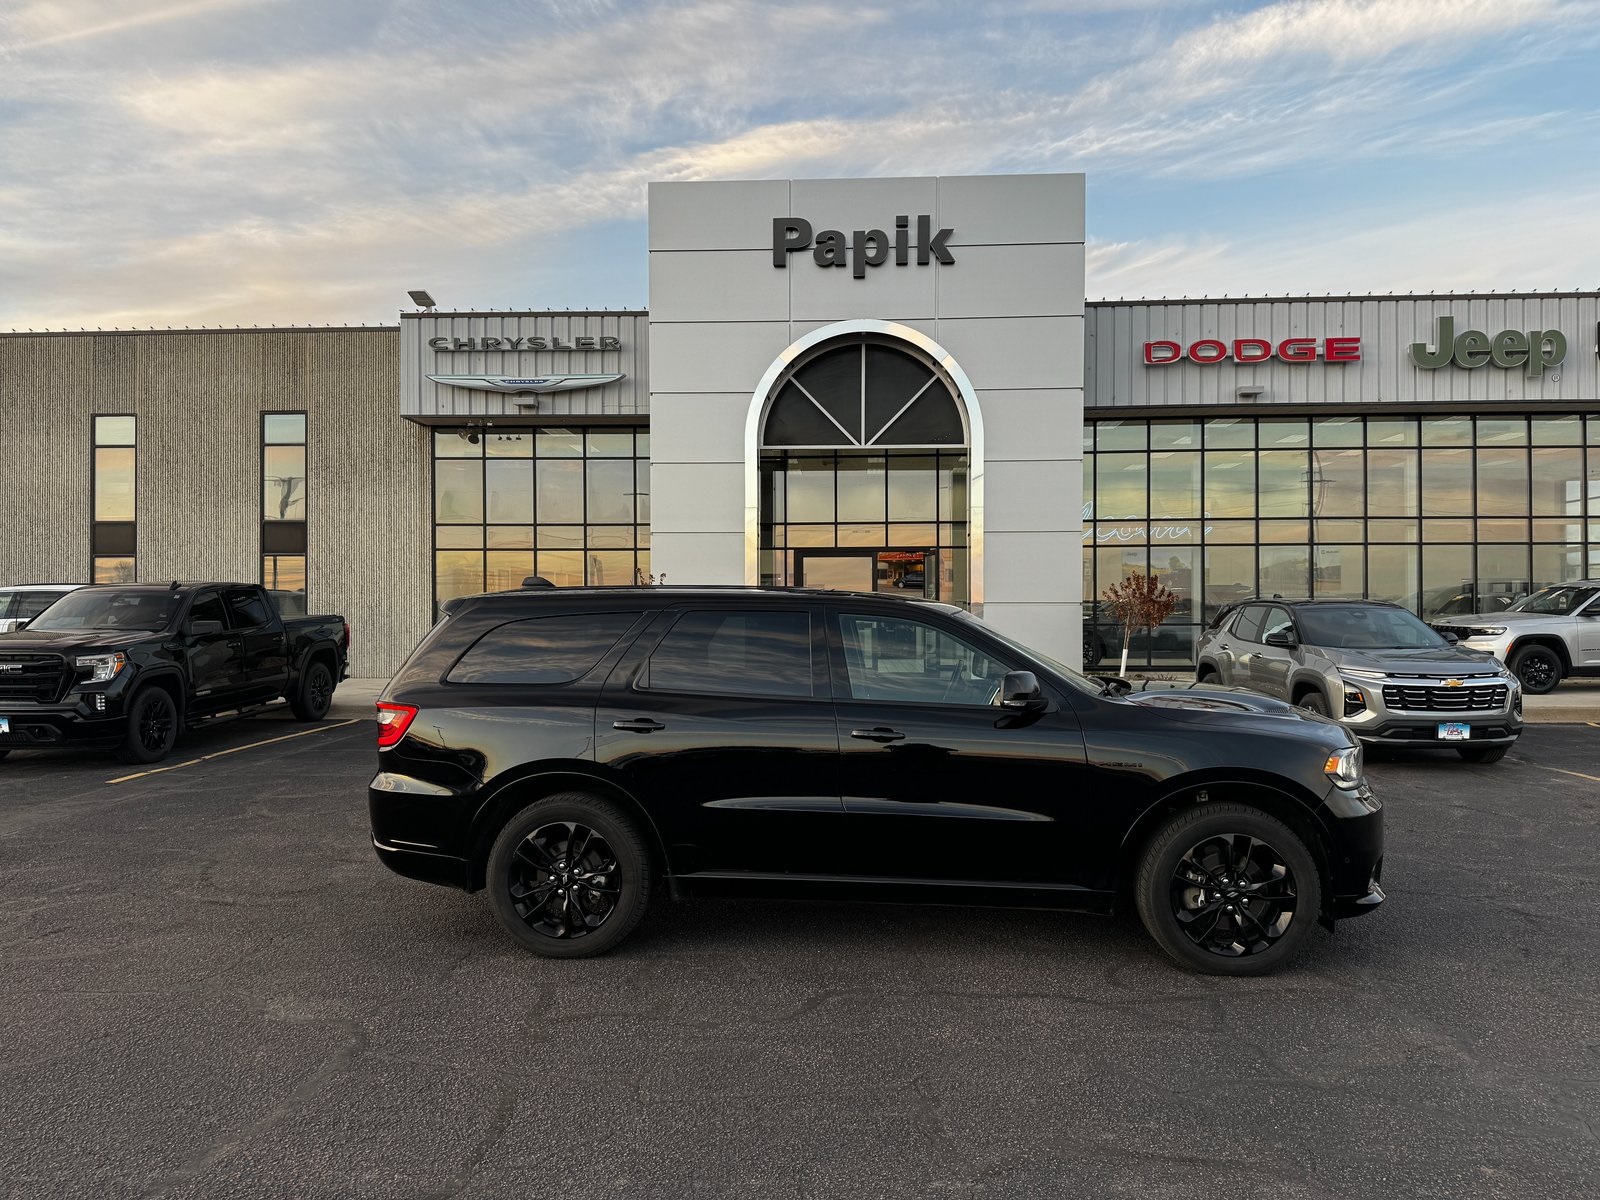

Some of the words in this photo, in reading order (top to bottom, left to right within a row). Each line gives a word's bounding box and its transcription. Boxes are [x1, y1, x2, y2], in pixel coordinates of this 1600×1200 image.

[772, 214, 956, 279] Papik
[428, 336, 622, 352] CHRYSLER
[1144, 337, 1361, 364] DODGE
[1409, 315, 1568, 379] Jeep
